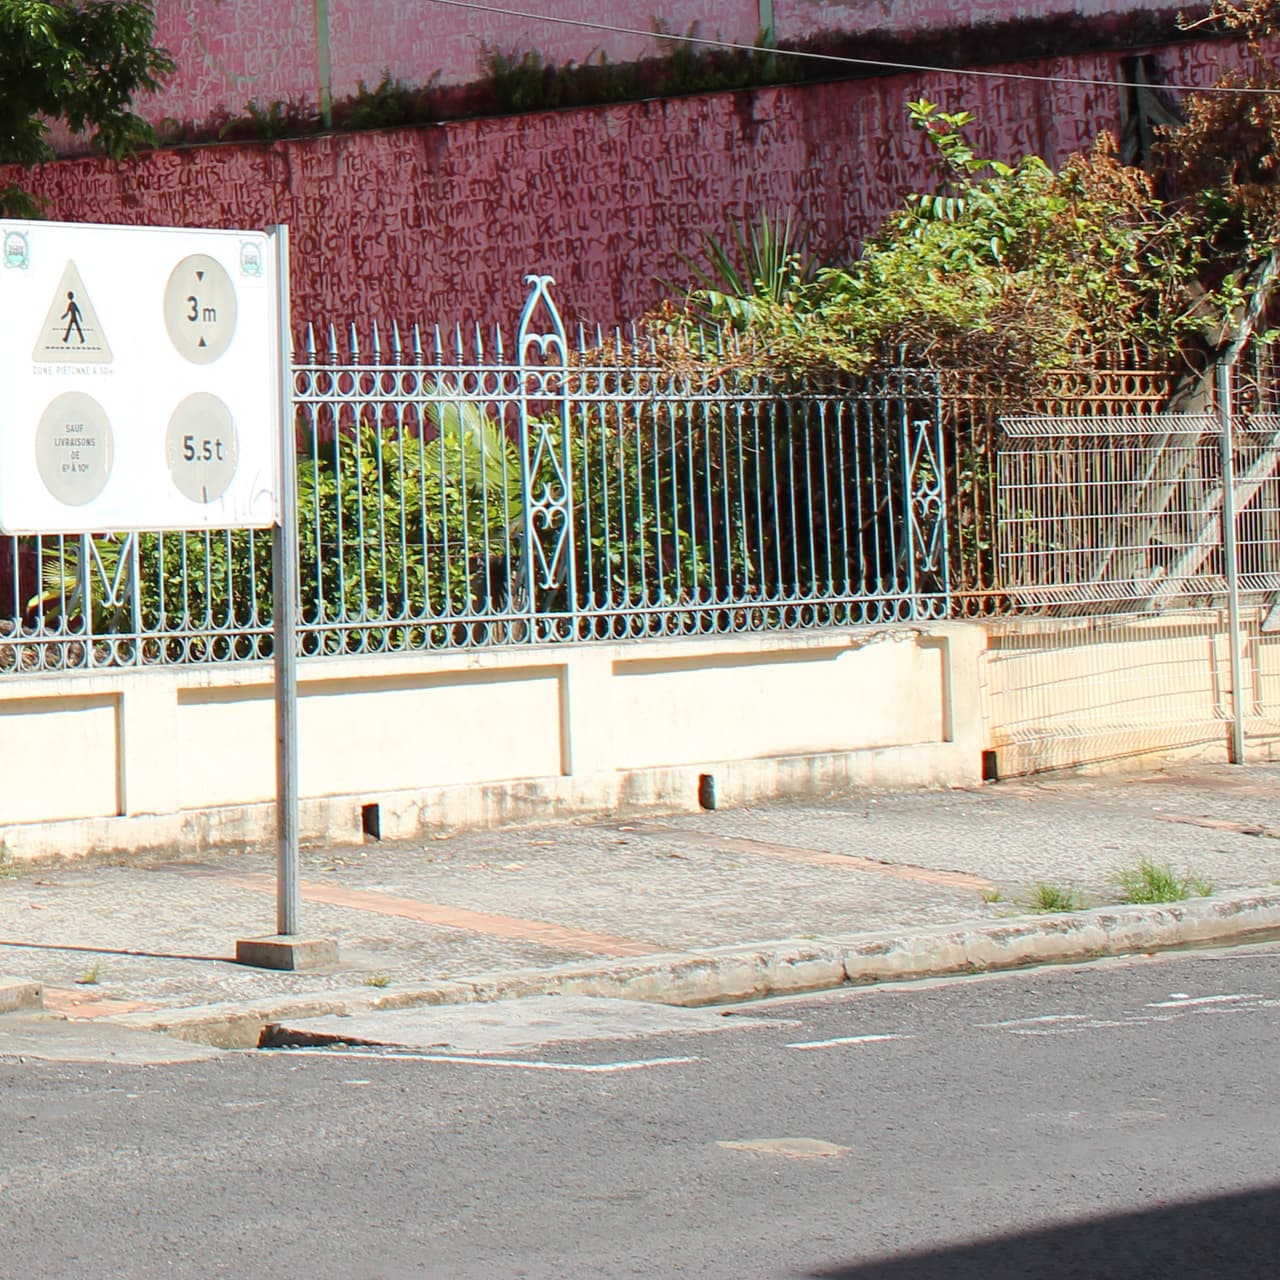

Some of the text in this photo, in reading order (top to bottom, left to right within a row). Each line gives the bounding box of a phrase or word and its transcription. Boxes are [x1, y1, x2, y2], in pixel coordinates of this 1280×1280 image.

[186, 295, 217, 322] 3 m
[65, 423, 84, 433] SAUF
[54, 437, 96, 447] LIVRAISONS
[183, 434, 224, 462] 5.5 t
[70, 450, 80, 460] DE
